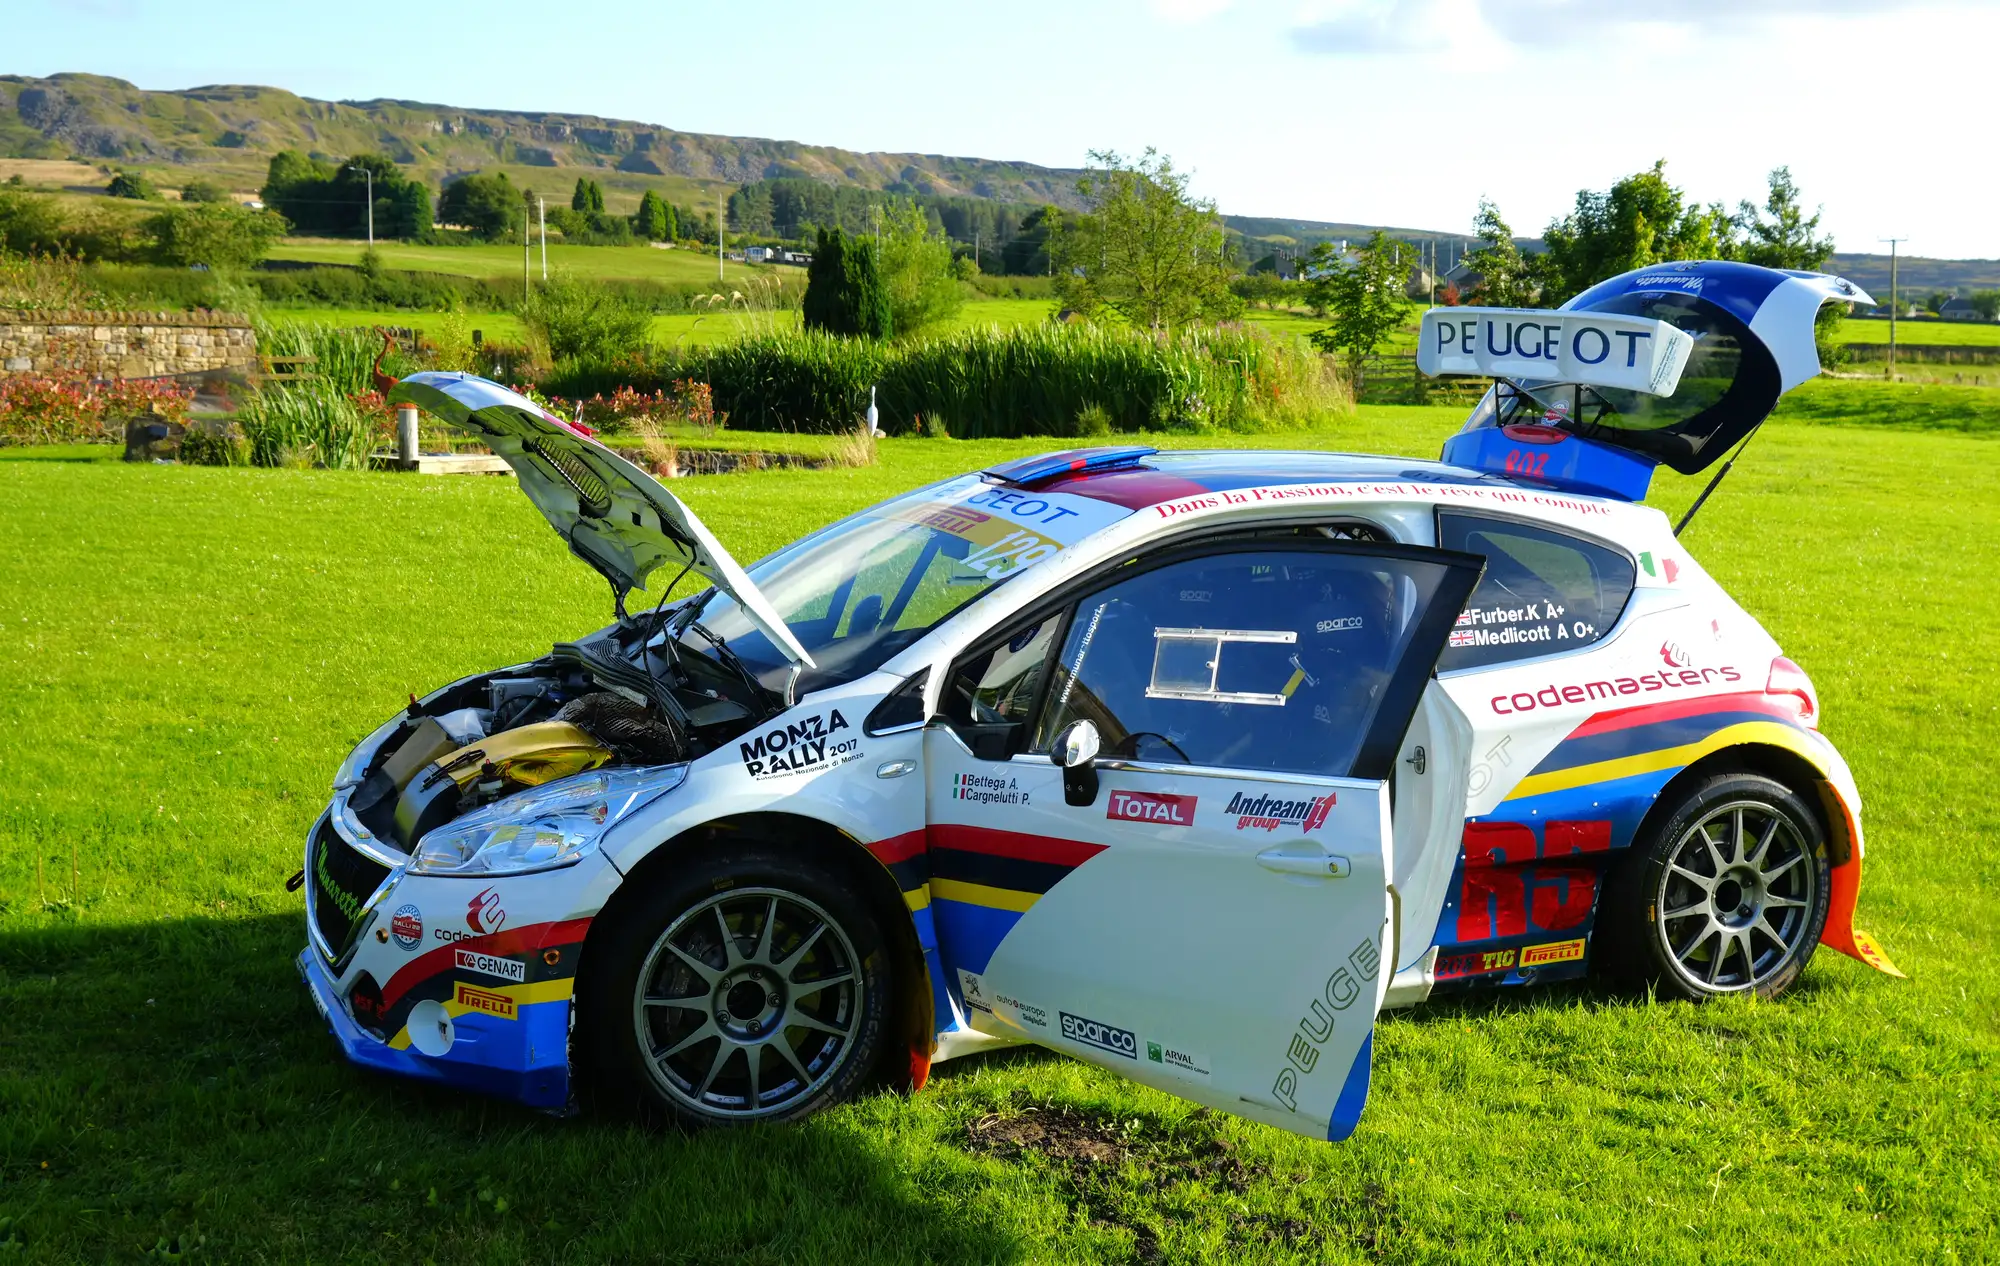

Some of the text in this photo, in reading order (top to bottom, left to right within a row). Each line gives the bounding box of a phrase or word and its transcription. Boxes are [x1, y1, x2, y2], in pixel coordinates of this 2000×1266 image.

[1437, 321, 1651, 367] PEUGEOT
[1155, 483, 1612, 519] Dans la Passion, c'est le rêve qui compte
[959, 529, 1057, 580] 129
[1317, 616, 1363, 633] sparco
[1471, 602, 1565, 625] Furber.K A+
[1474, 626, 1551, 646] Medlicott
[1557, 623, 1569, 639] A
[1491, 666, 1741, 715] codemasters
[740, 709, 849, 762] MONZA
[746, 736, 857, 777] RALLY 2017
[795, 763, 829, 775] Nazionale
[832, 759, 839, 767] di
[841, 752, 864, 764] Monza
[967, 774, 1019, 791] Bettega A.
[966, 788, 1031, 805] Cargnelutti P.
[1224, 791, 1317, 820] Andreani
[1236, 816, 1281, 832] group
[1456, 820, 1612, 943] R5
[1524, 942, 1580, 963] PIRELLI
[458, 986, 513, 1015] PIRELLI
[996, 994, 1013, 1006] auto
[1062, 1015, 1135, 1051] sparco
[1165, 1050, 1194, 1065] ARVAL
